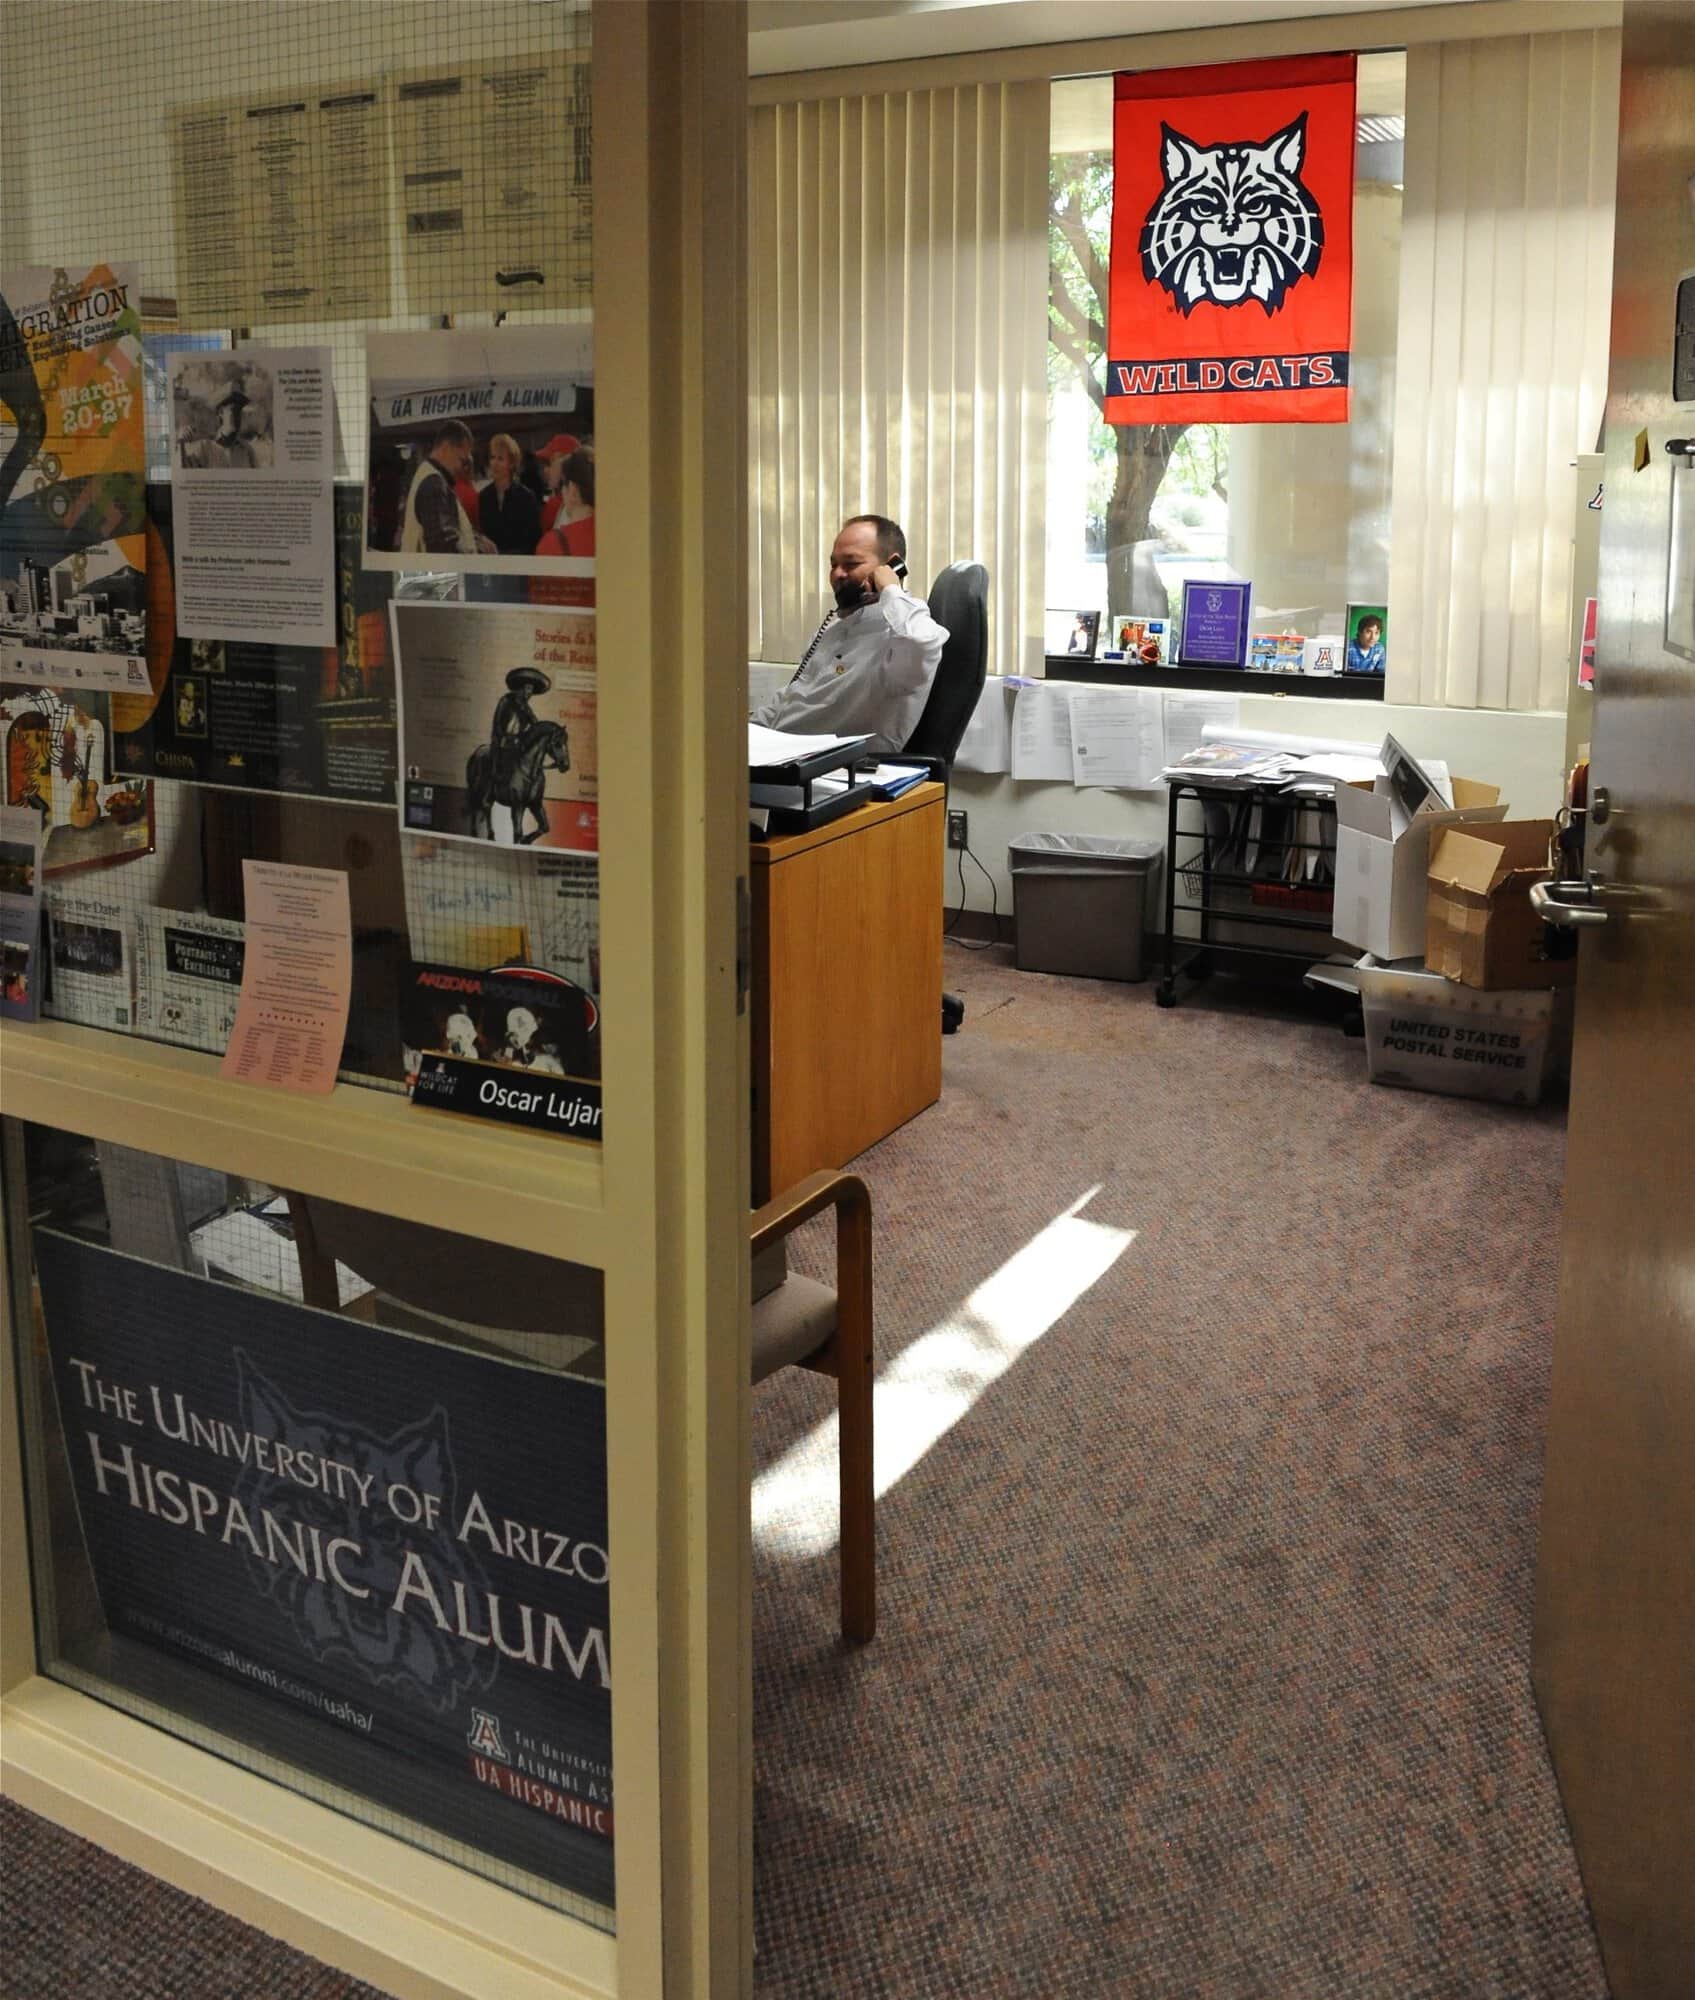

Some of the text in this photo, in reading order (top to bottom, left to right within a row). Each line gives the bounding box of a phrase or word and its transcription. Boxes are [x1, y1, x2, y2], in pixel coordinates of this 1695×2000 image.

[59, 374, 128, 409] March
[1118, 356, 1335, 394] WILDCATS
[63, 395, 133, 433] 20-27
[390, 388, 561, 419] UA HISPANIC ALUMNI
[535, 629, 570, 644] Stories
[417, 970, 483, 995] ARIZONA
[1389, 1018, 1521, 1049] UNITED STATES
[1382, 1036, 1528, 1070] POSTAL SERVICE
[420, 1070, 459, 1086] WILDCAT
[479, 1079, 544, 1113] Oscar
[70, 1357, 609, 1585] THE UNIVERSITY OF ARIZO
[86, 1430, 612, 1690] HISPANIC ALUM
[542, 1743, 611, 1778] UNIVERSIT
[474, 1758, 606, 1834] UA HISPANIC
[517, 1753, 612, 1804] ALUMNI AS
